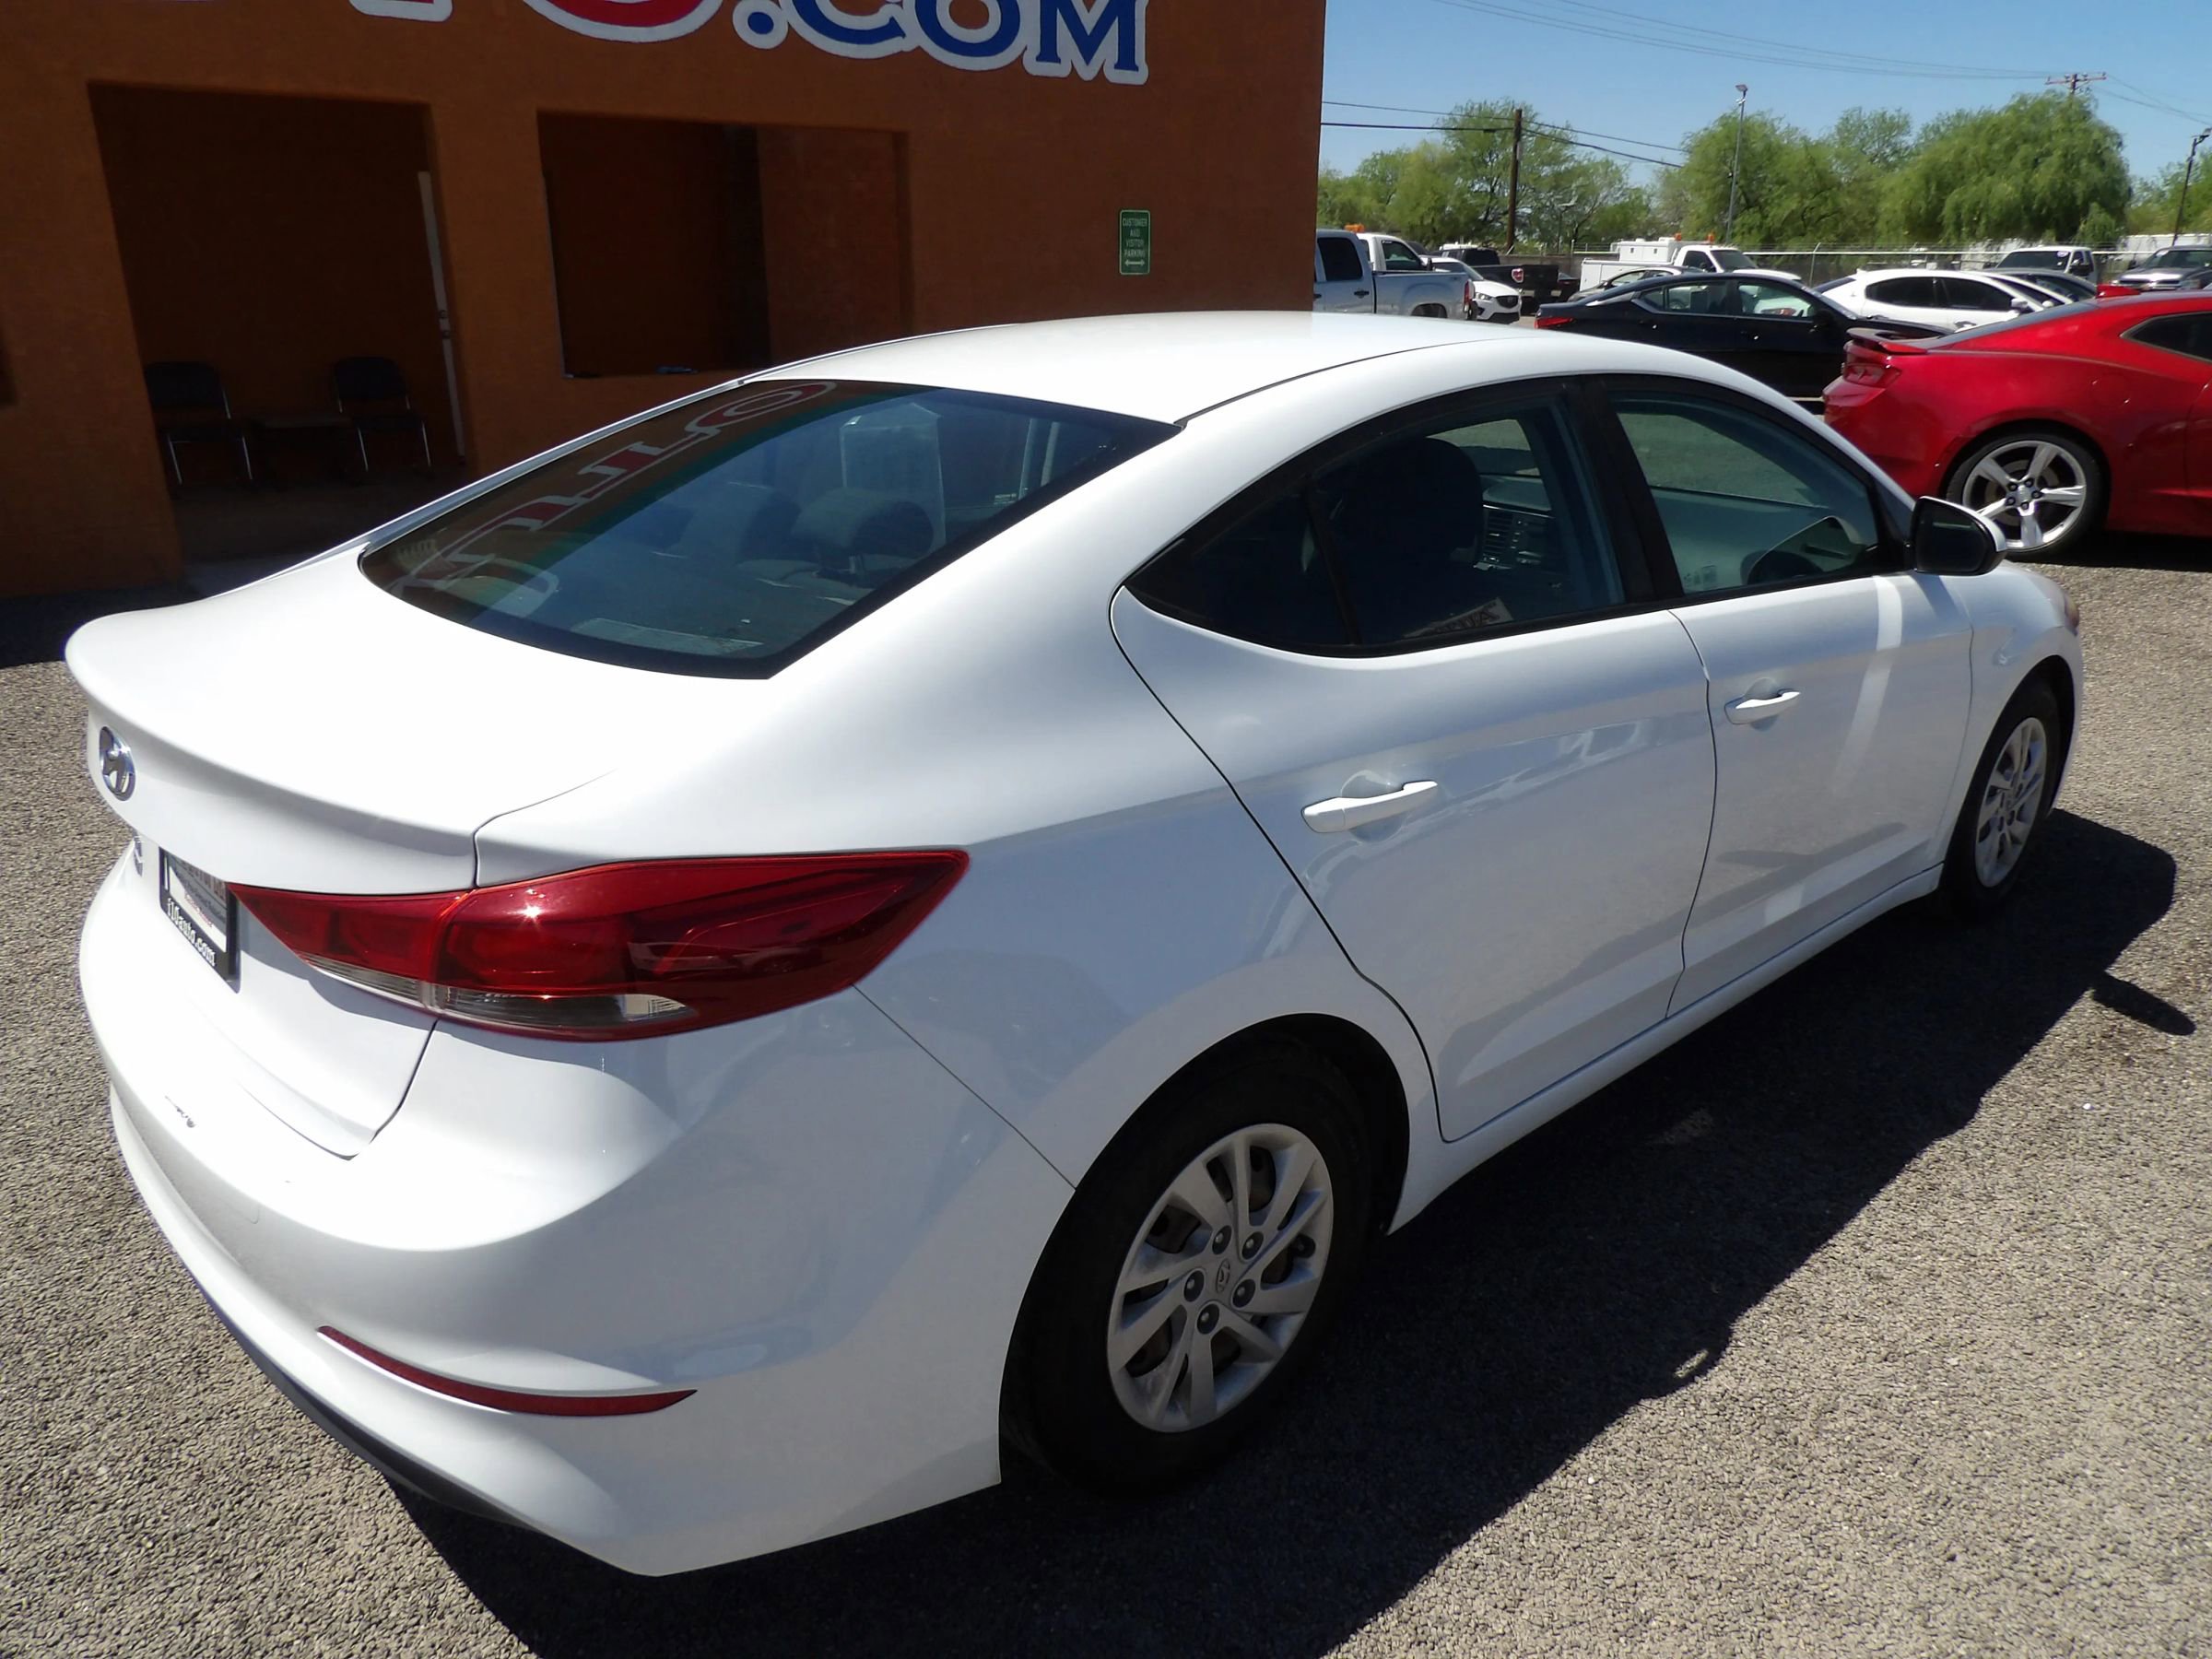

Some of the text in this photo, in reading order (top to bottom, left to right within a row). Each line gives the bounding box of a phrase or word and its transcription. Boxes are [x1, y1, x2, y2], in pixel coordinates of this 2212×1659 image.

[1130, 228, 1141, 238] AND
[1125, 238, 1144, 248] VISITOR
[1124, 249, 1146, 258] PARKING
